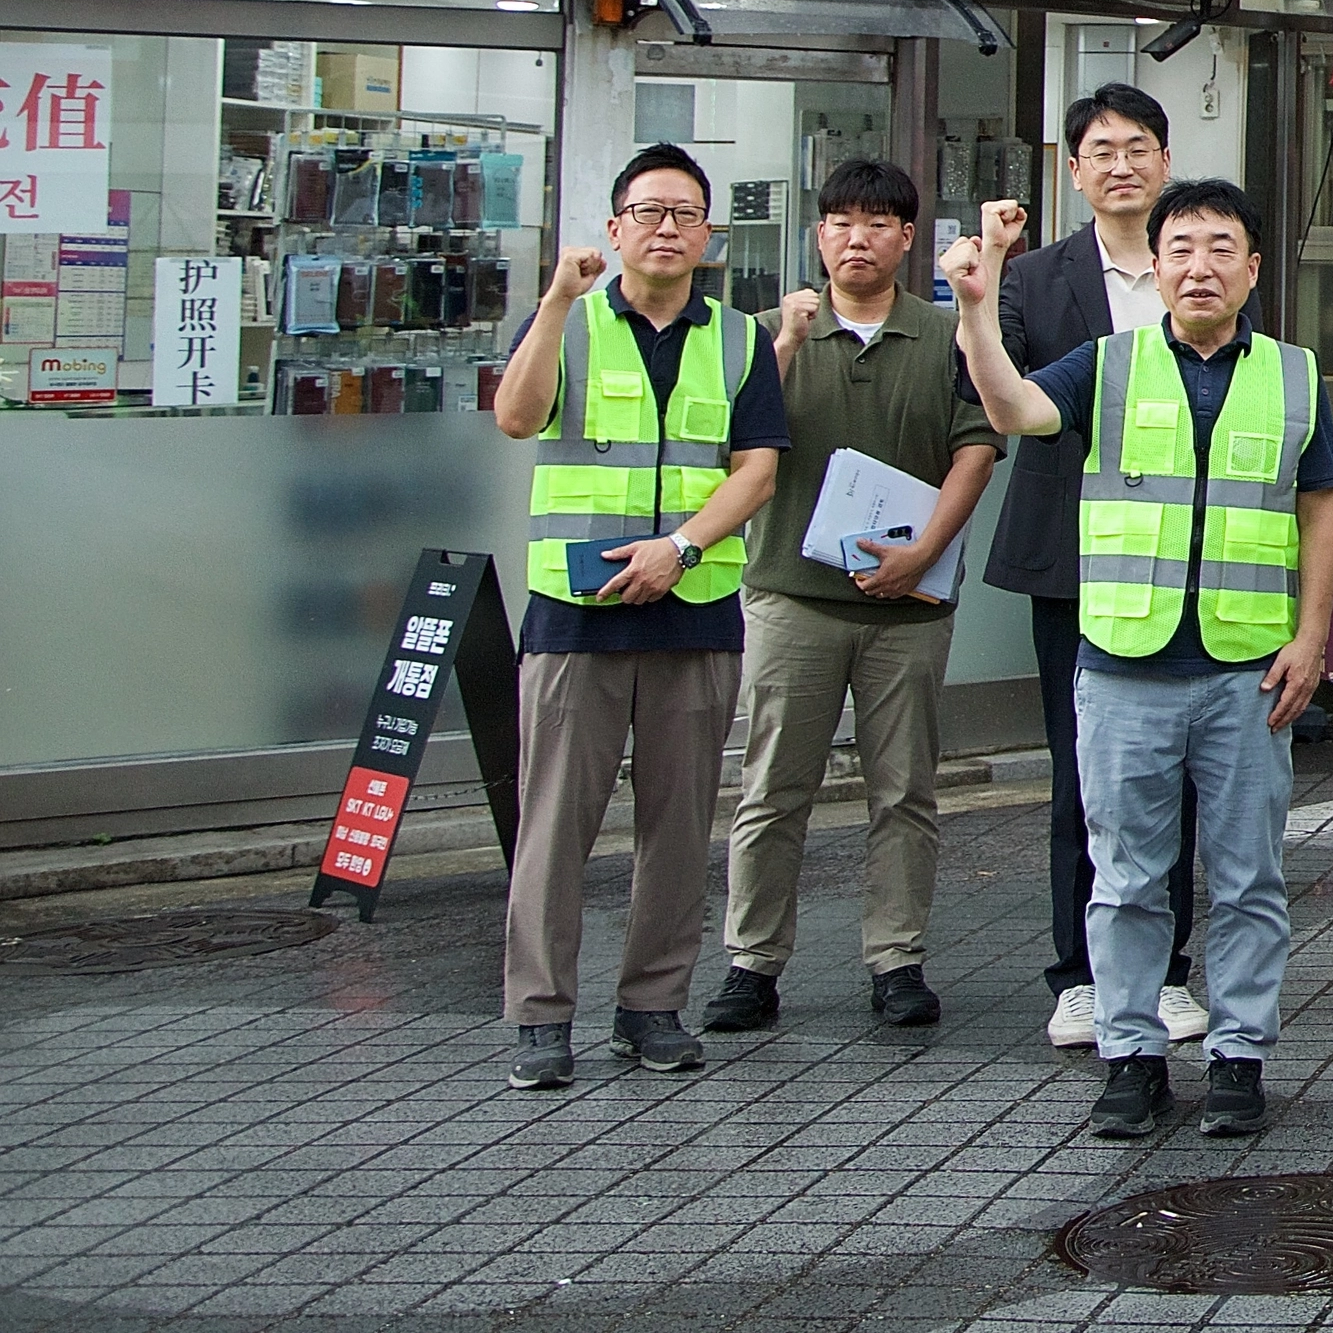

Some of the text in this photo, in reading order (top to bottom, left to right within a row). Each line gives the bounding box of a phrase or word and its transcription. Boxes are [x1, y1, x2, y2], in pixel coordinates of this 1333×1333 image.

[0, 72, 107, 152] 值
[175, 259, 219, 406] 护照开卡
[401, 616, 454, 654] 알뜰폰
[386, 659, 439, 699] 개통점
